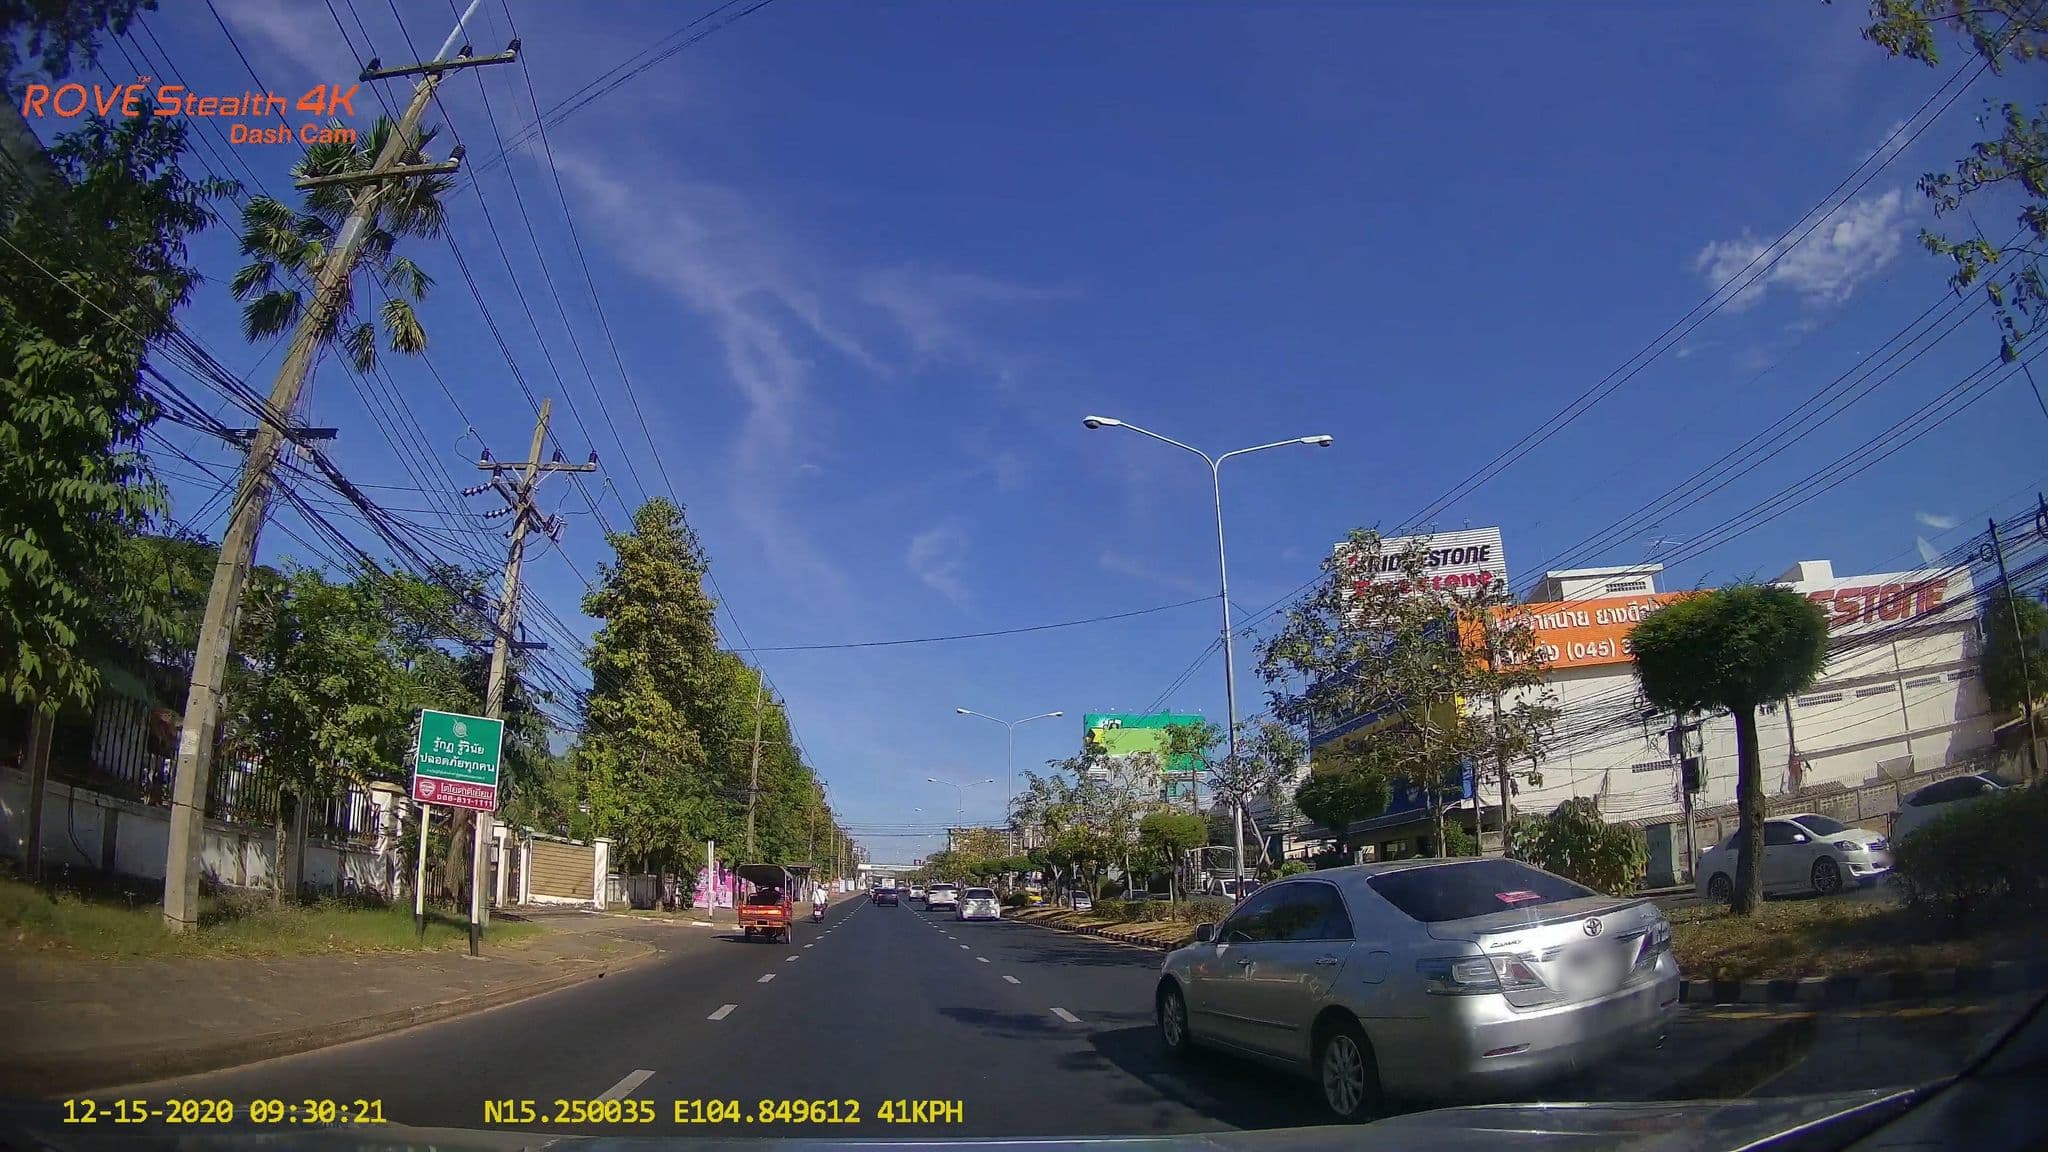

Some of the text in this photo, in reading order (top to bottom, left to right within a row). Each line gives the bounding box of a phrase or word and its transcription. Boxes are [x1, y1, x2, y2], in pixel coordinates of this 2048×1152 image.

[1808, 578, 1949, 626] ESTONE
[1567, 637, 1616, 661] (045)
[420, 752, 495, 773] ปลอดภัยทุกคน
